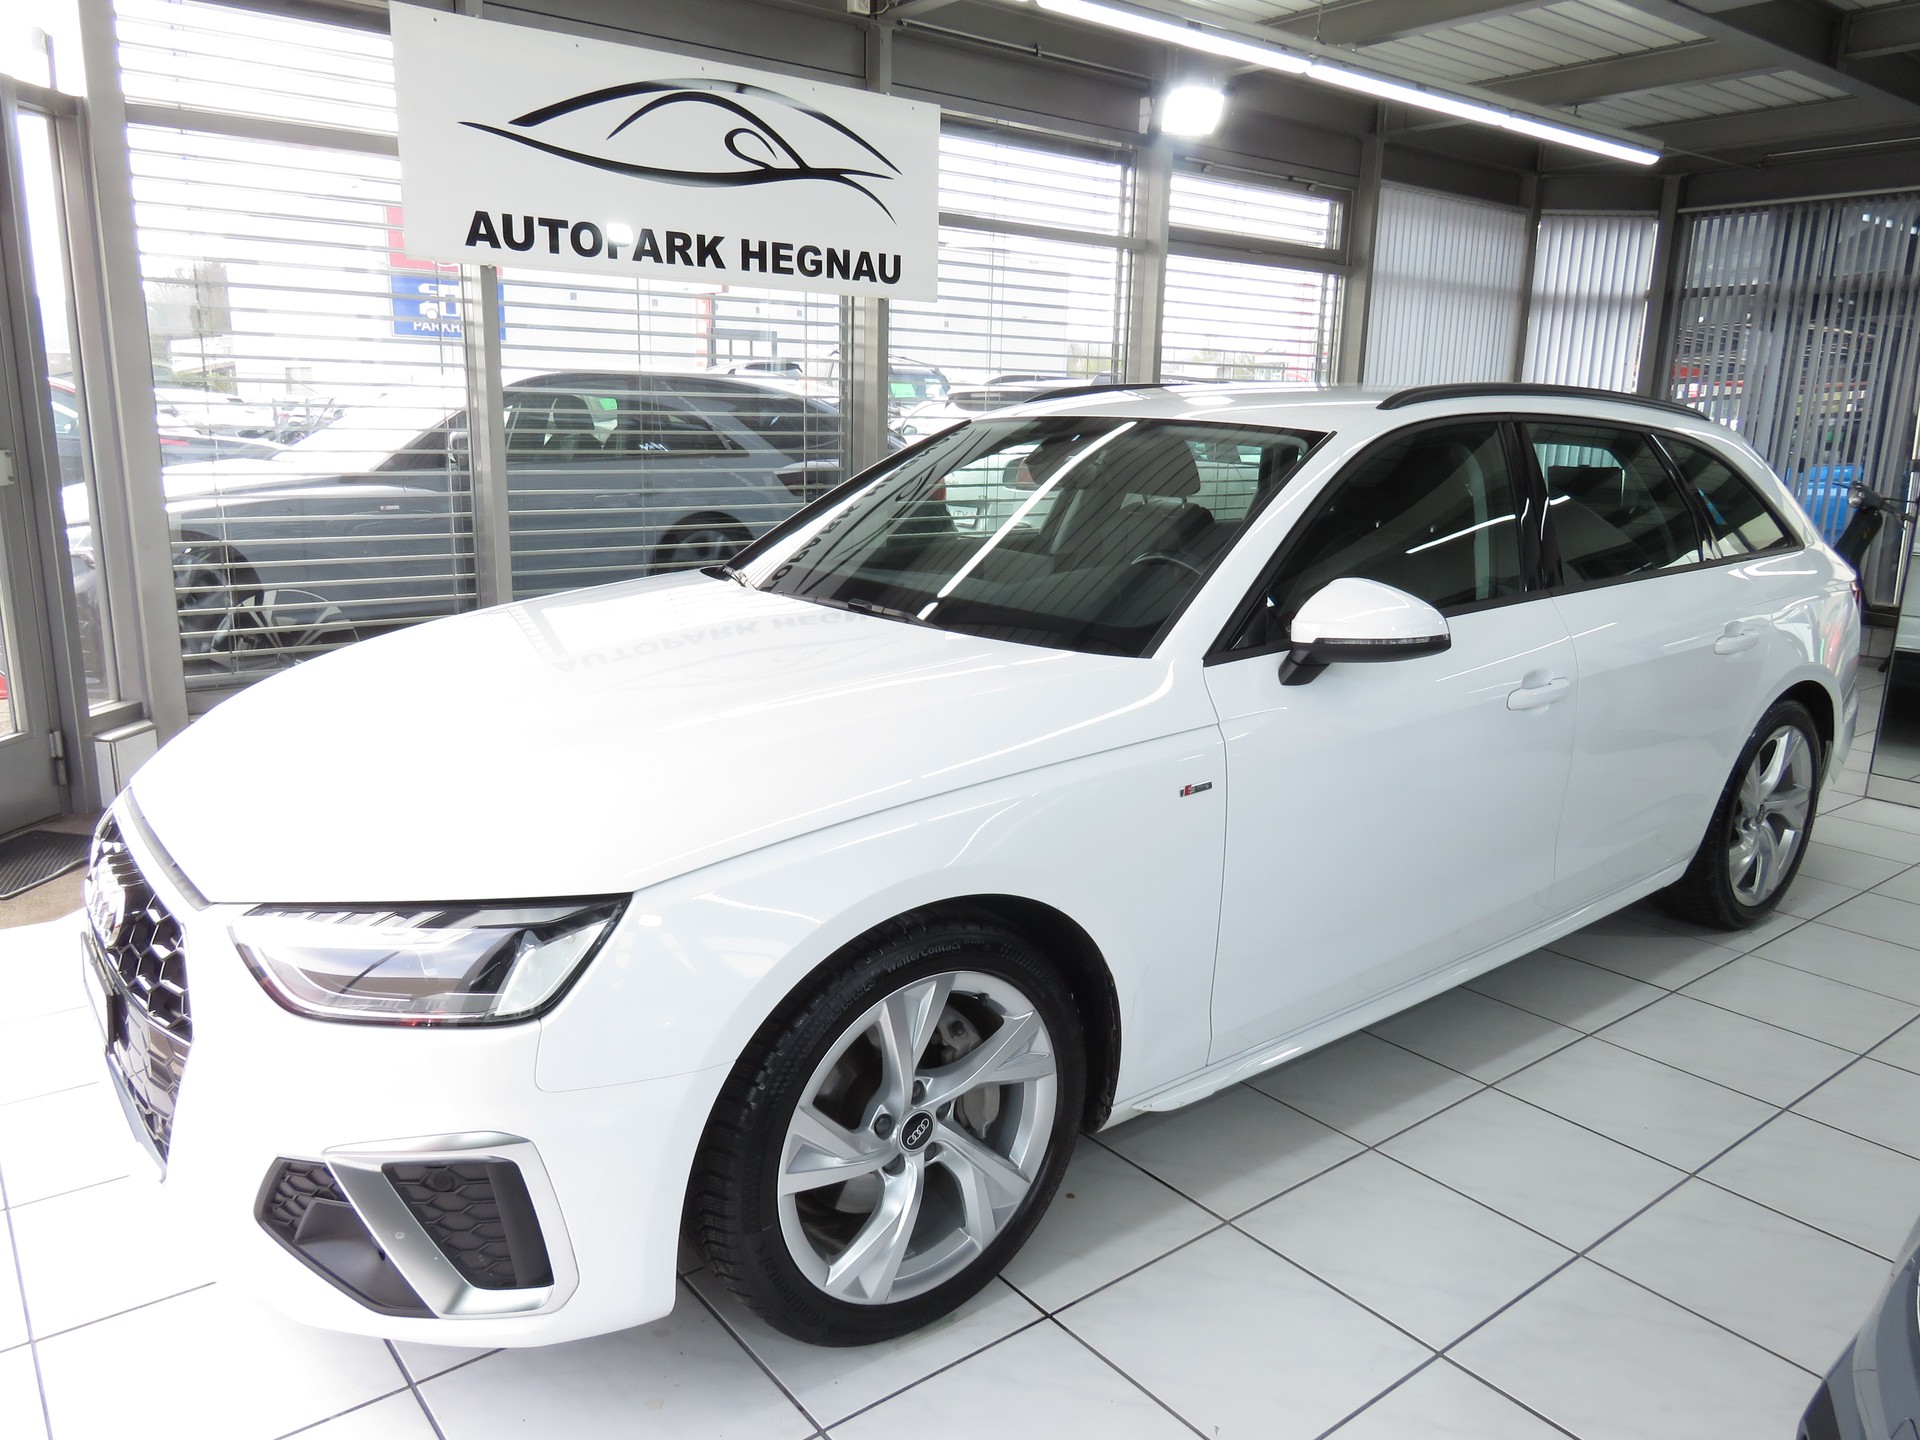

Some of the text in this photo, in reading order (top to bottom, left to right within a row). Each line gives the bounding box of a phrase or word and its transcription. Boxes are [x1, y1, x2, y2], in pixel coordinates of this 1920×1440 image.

[740, 238, 902, 285] HEGNAU
[412, 321, 462, 333] PARKH
[884, 940, 962, 973] WinterContact
